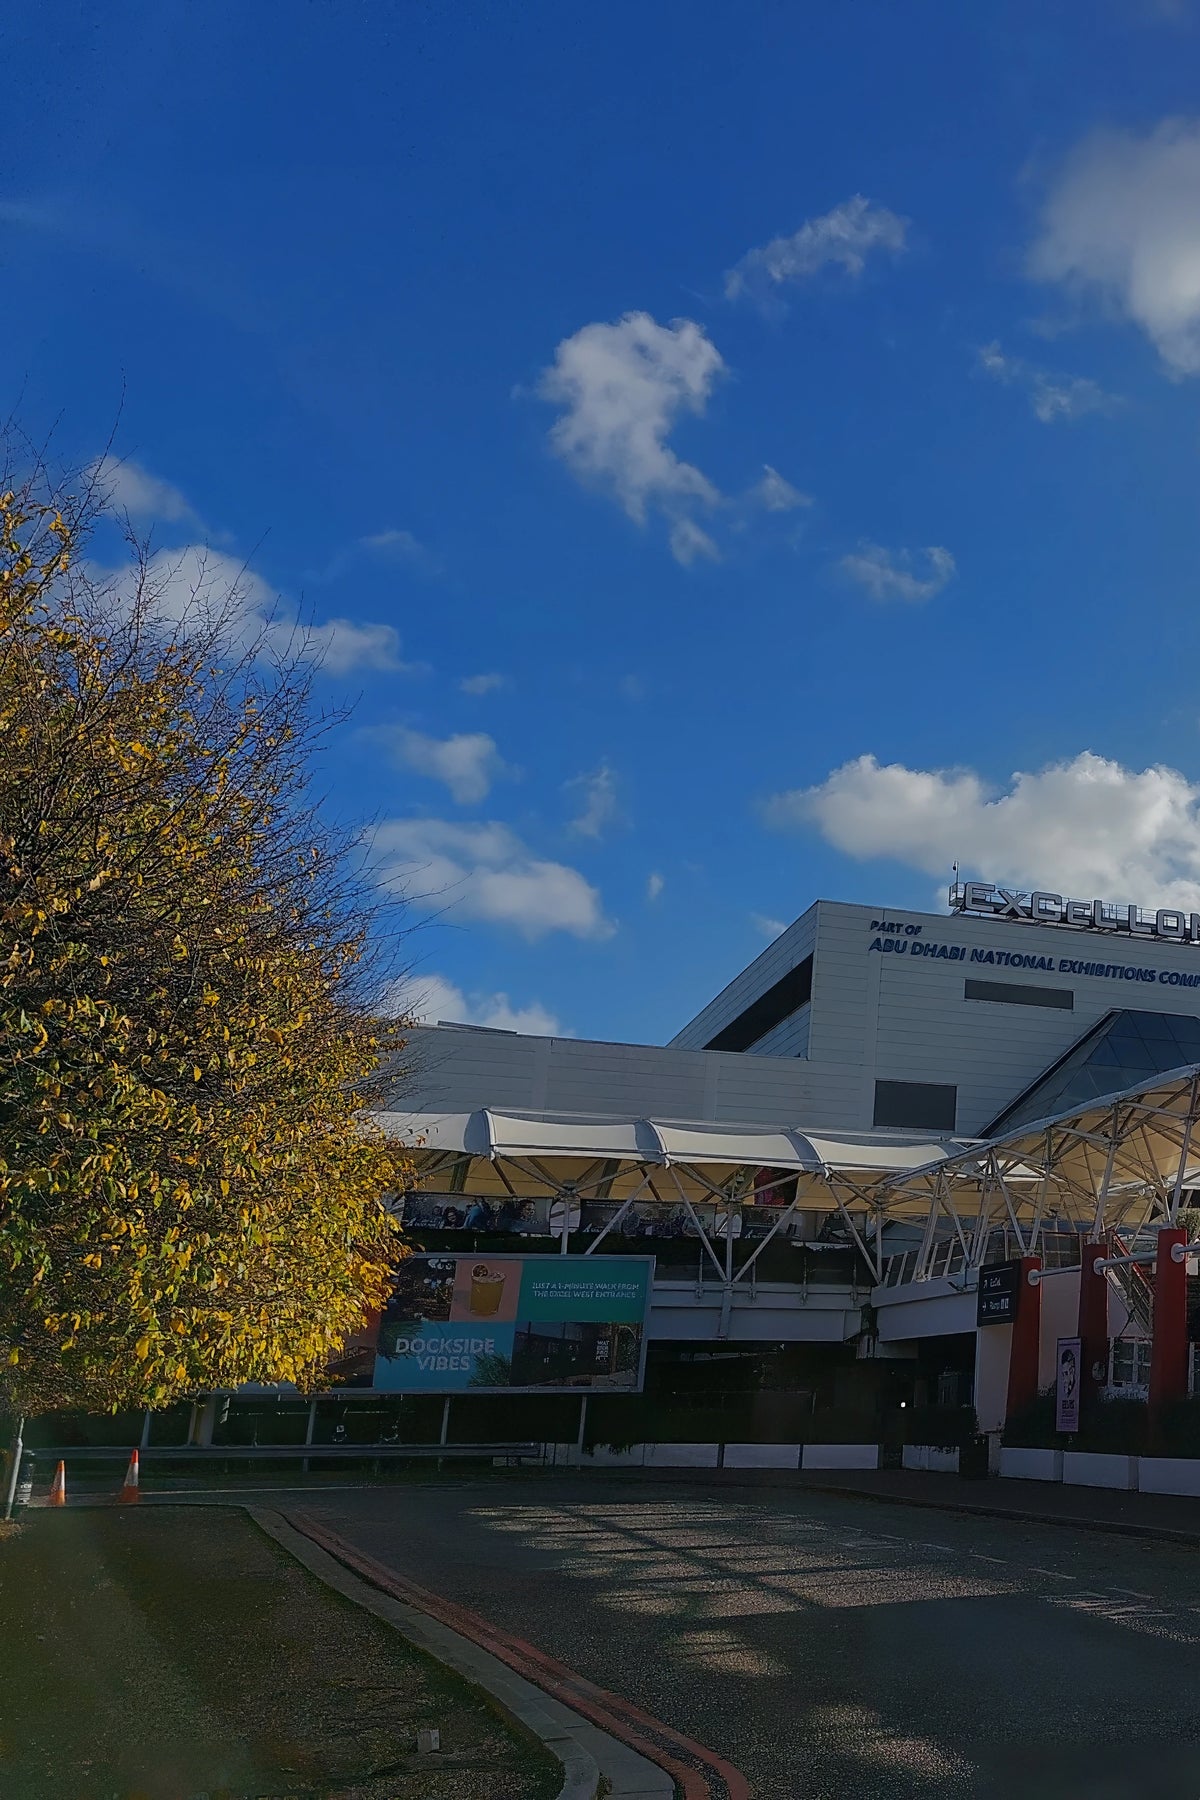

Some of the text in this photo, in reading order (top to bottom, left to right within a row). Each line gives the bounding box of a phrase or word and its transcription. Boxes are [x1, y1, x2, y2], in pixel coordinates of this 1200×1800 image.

[870, 920, 922, 936] PART OF
[869, 937, 908, 954] ABU
[911, 941, 966, 961] DHABI
[969, 948, 1055, 971] NATIONAL
[1058, 959, 1157, 983] EXHIBITIONS
[395, 1337, 495, 1355] DOCKSIDE
[416, 1355, 471, 1371] VIBES
